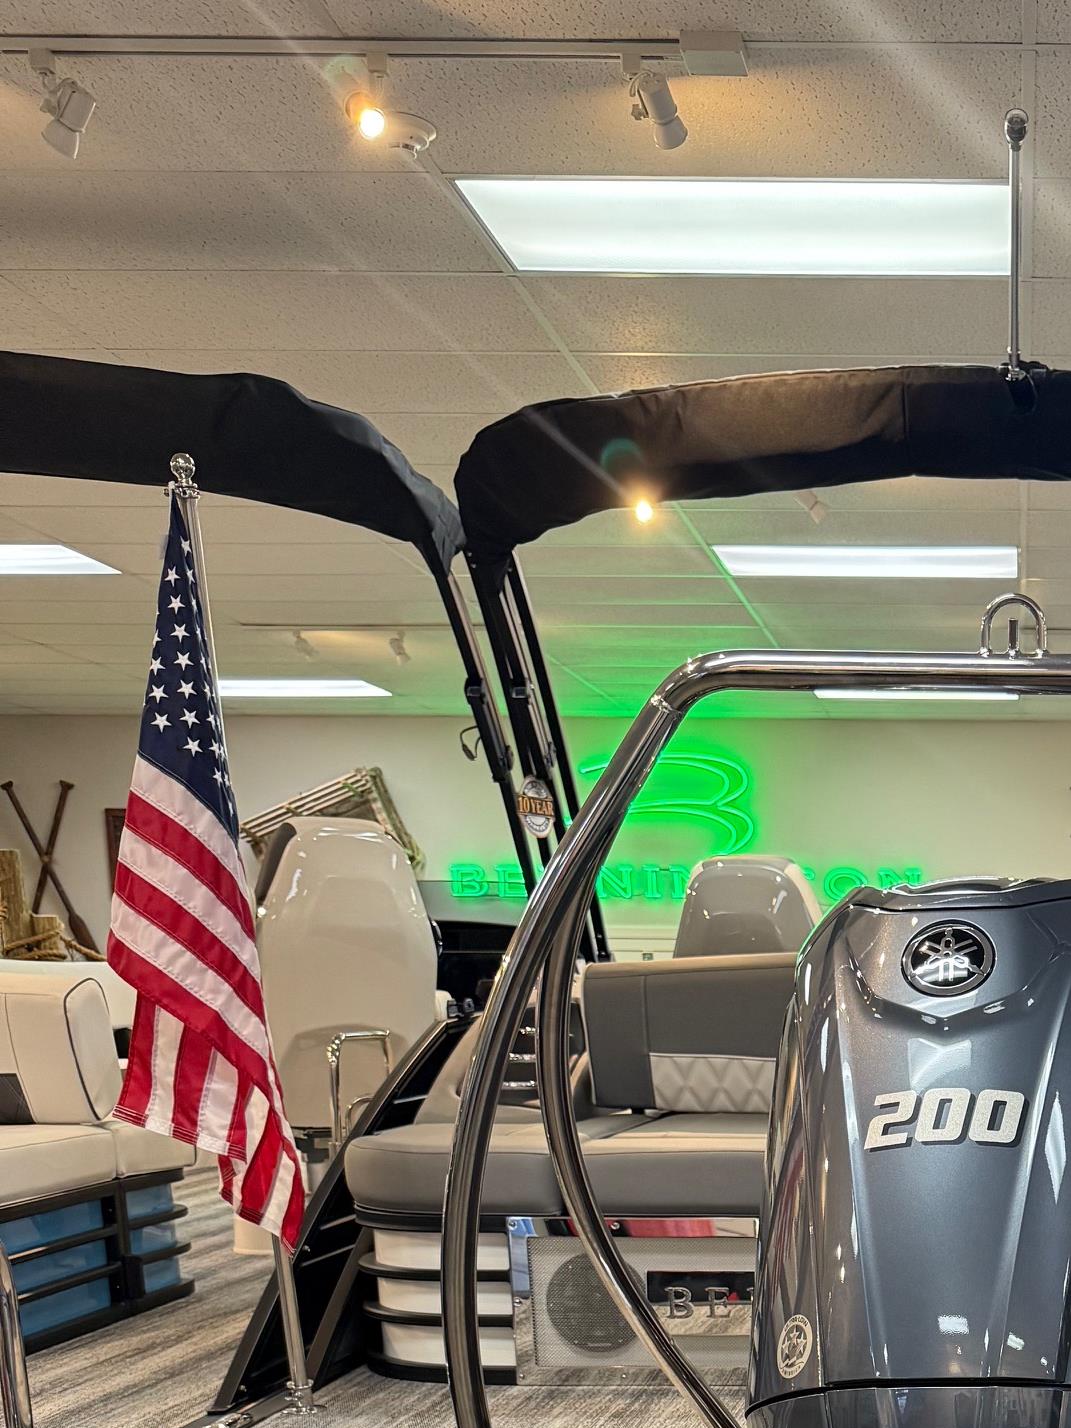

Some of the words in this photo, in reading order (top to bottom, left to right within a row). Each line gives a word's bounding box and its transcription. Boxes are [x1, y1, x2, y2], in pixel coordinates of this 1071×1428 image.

[518, 796, 530, 813] 10
[530, 798, 553, 816] YEAR
[864, 1087, 1028, 1151] 200
